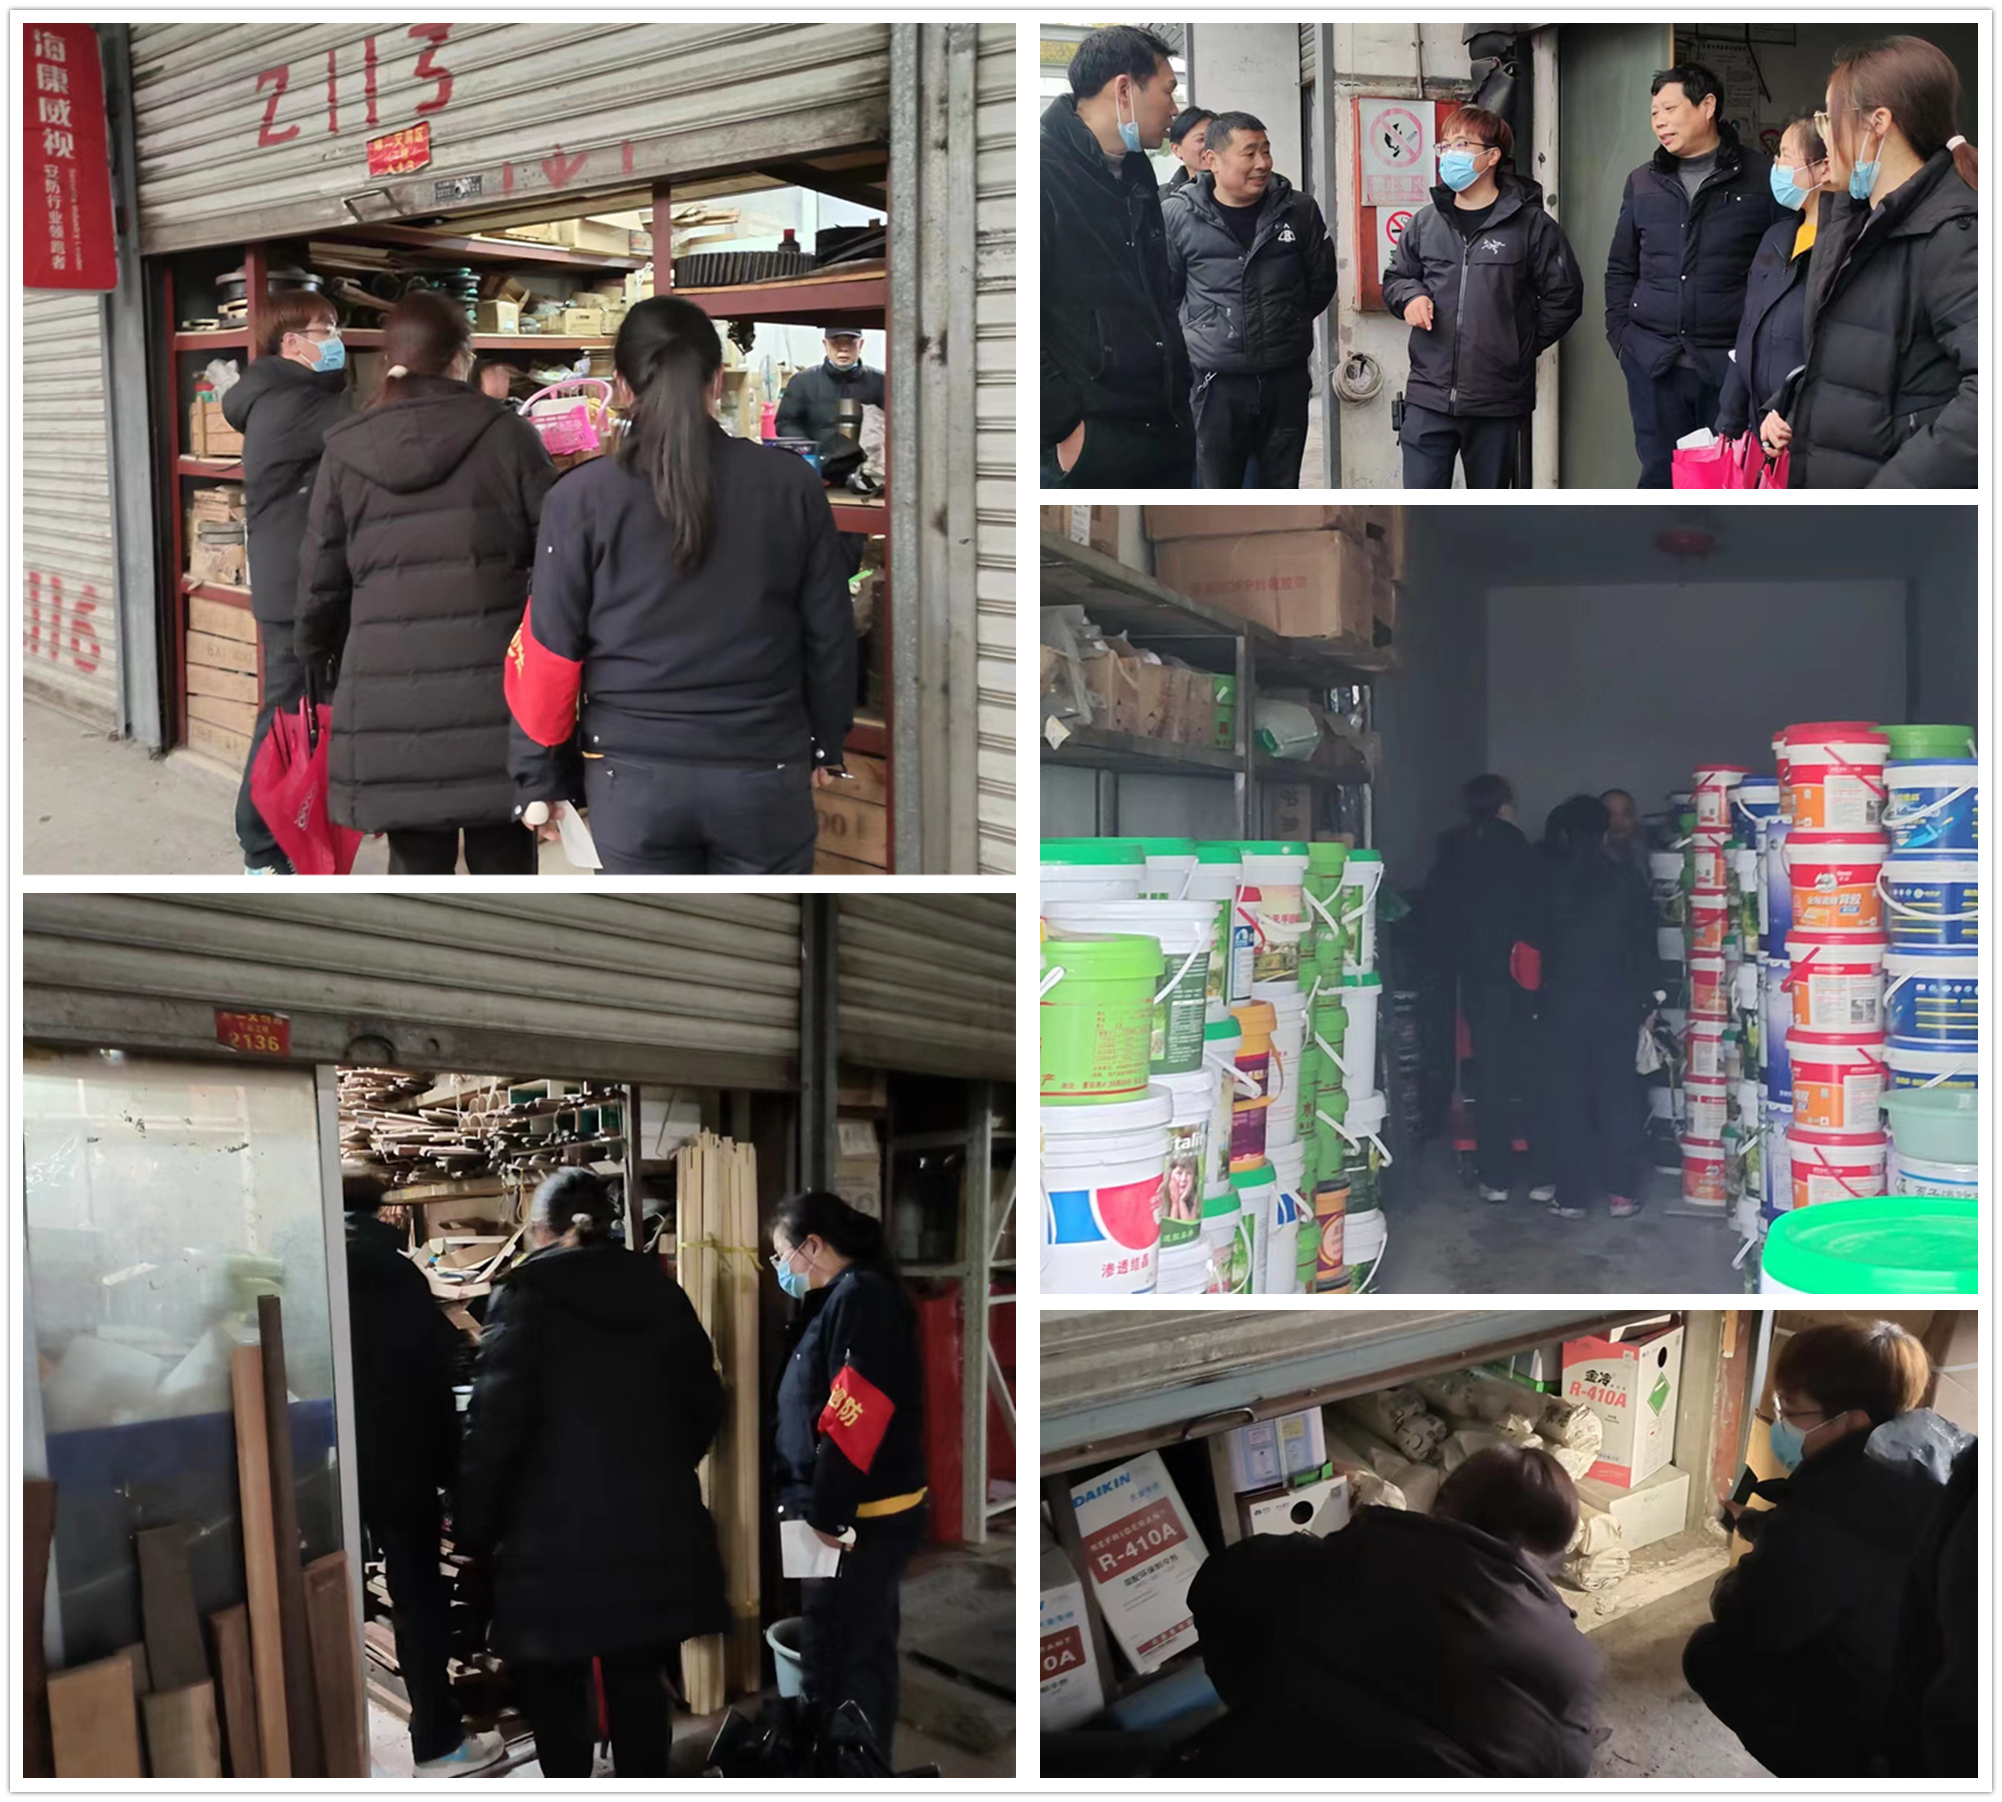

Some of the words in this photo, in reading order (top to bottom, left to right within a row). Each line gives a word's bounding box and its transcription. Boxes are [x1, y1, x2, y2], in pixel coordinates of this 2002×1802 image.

[33, 28, 75, 160] 海康威视
[255, 22, 453, 147] 2113
[23, 570, 101, 674] 116
[229, 1032, 280, 1052] 2136
[1568, 1380, 1627, 1408] R-410A
[1584, 1369, 1612, 1387] 金冷
[1072, 1472, 1132, 1509] DAIKIN
[1090, 1508, 1166, 1552] REFRIGERANT
[1098, 1522, 1178, 1573] R-410A
